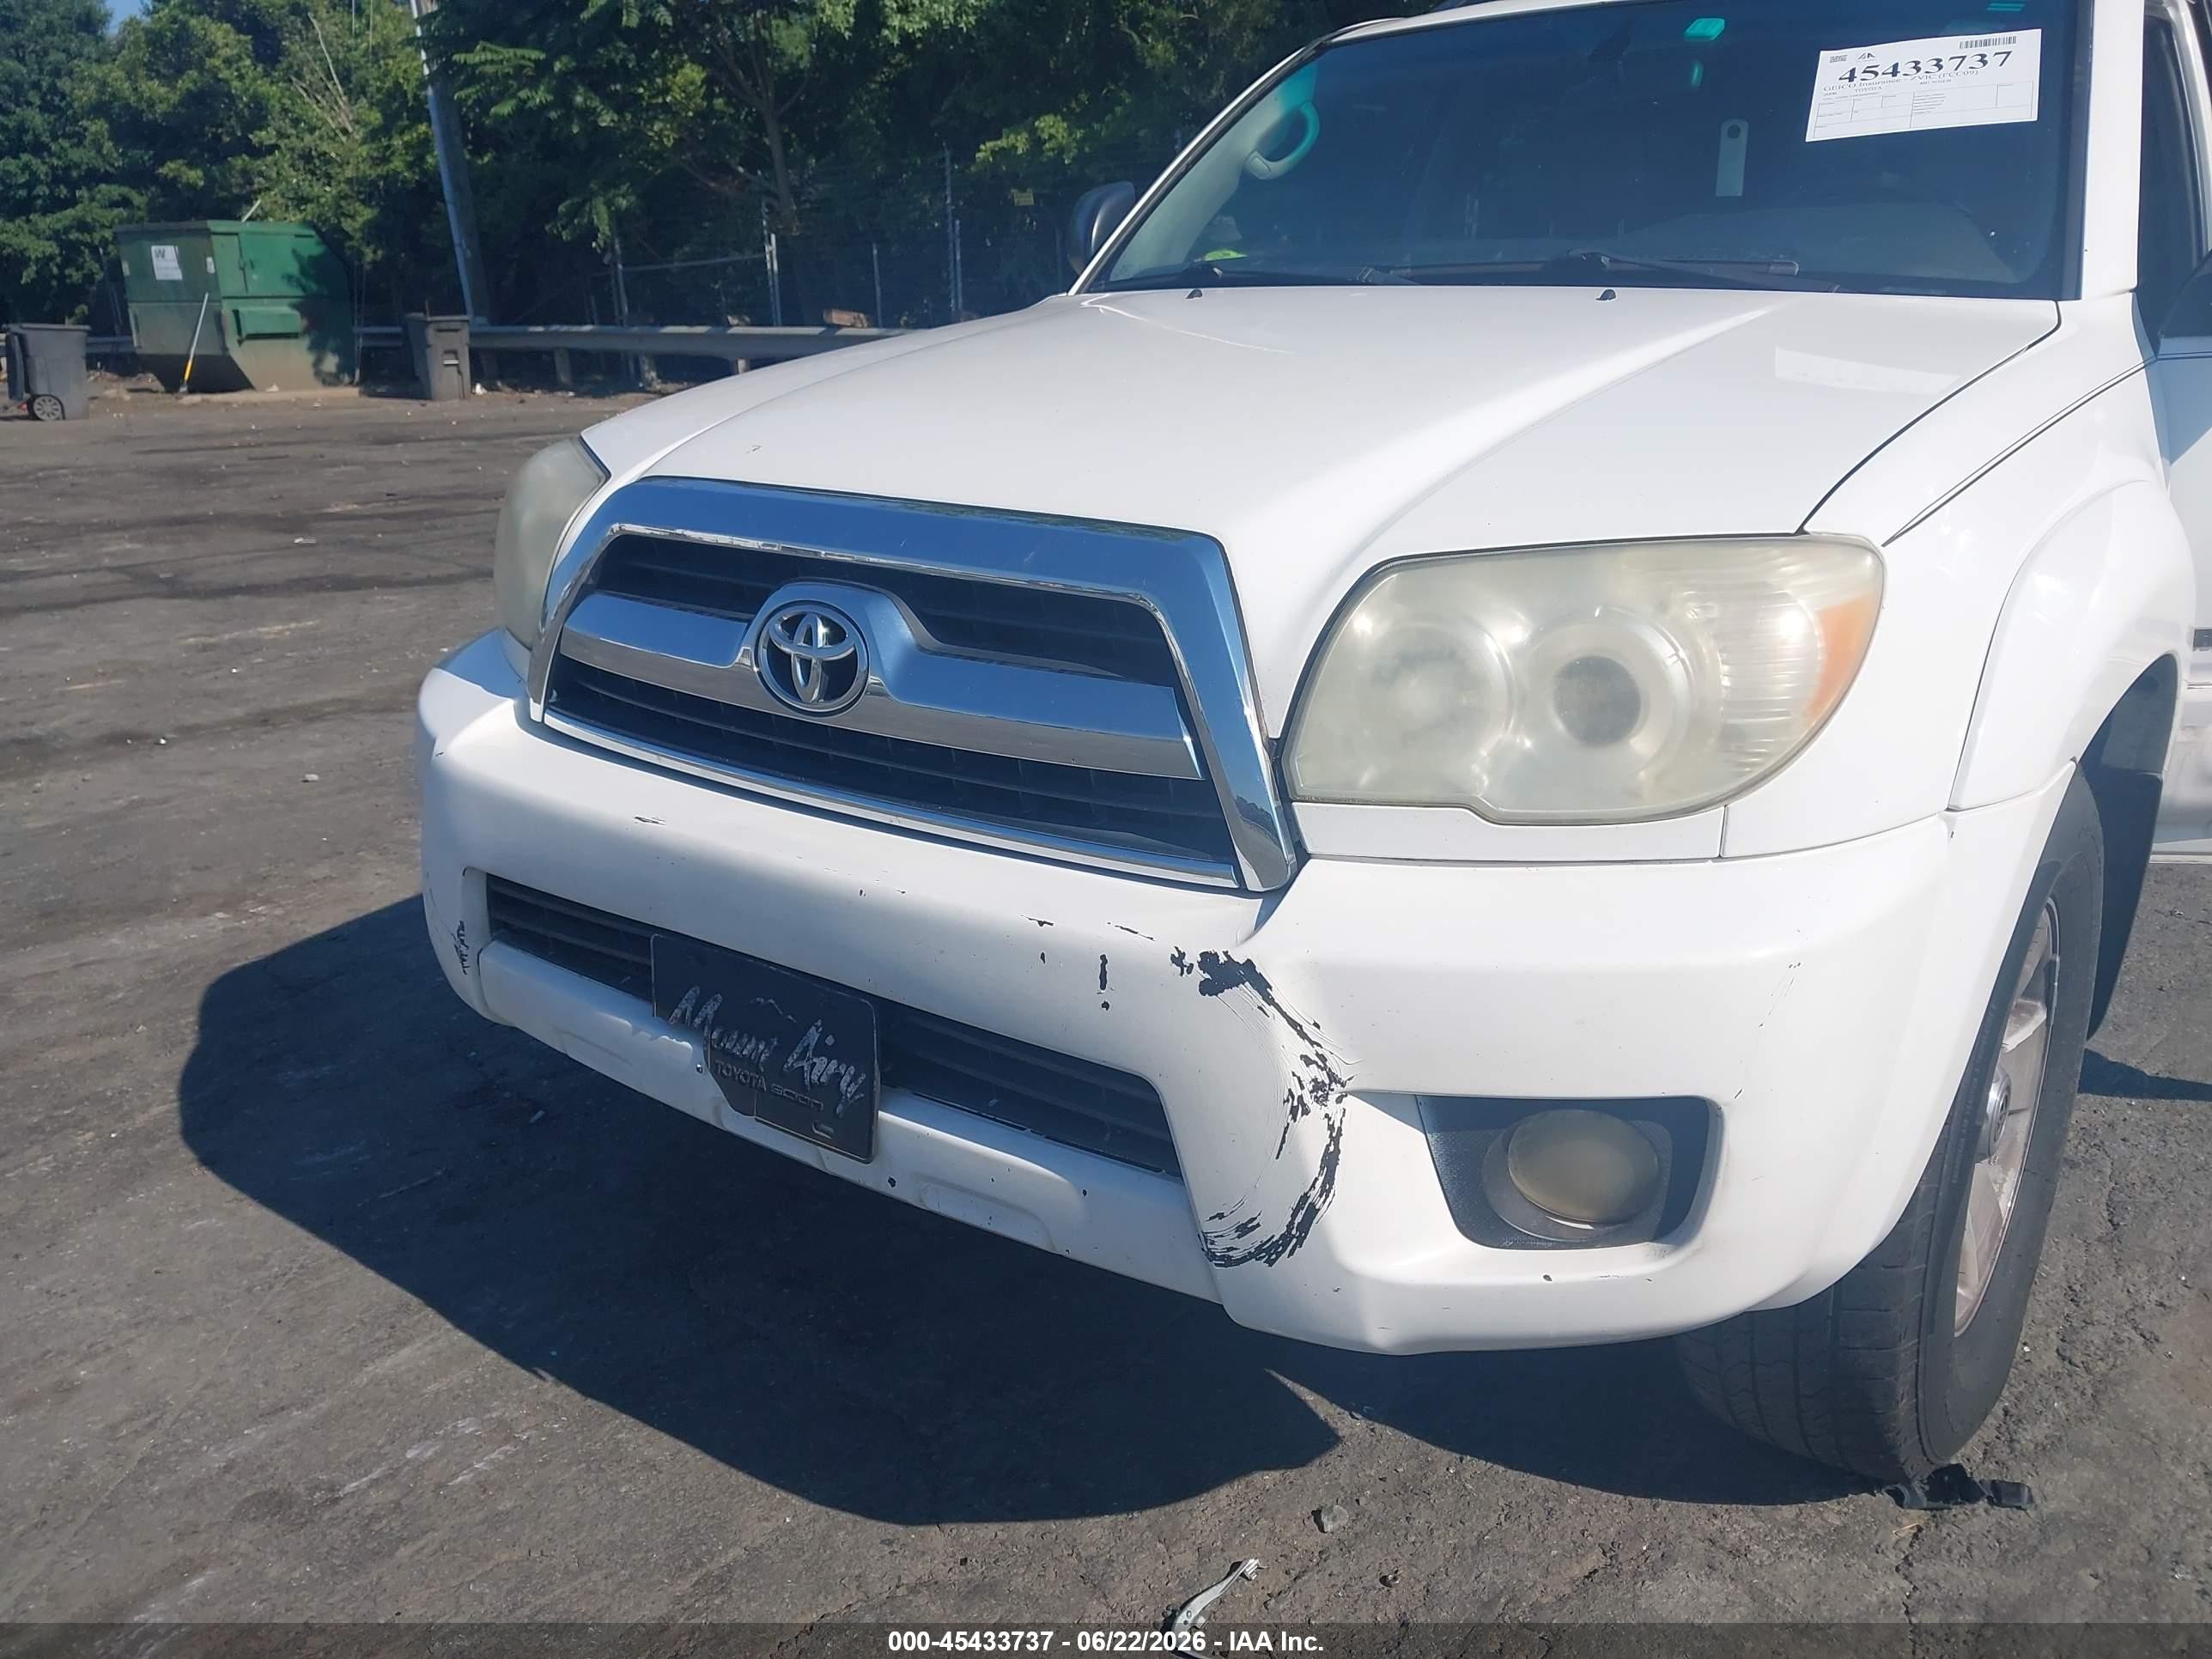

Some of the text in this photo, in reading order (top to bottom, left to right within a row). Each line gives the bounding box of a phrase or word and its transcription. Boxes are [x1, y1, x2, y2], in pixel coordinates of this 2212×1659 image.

[1838, 50, 2013, 83] 45433737
[1823, 83, 1856, 92] GEICO
[714, 1060, 768, 1092] TOYOTA
[782, 1018, 866, 1116] Airy
